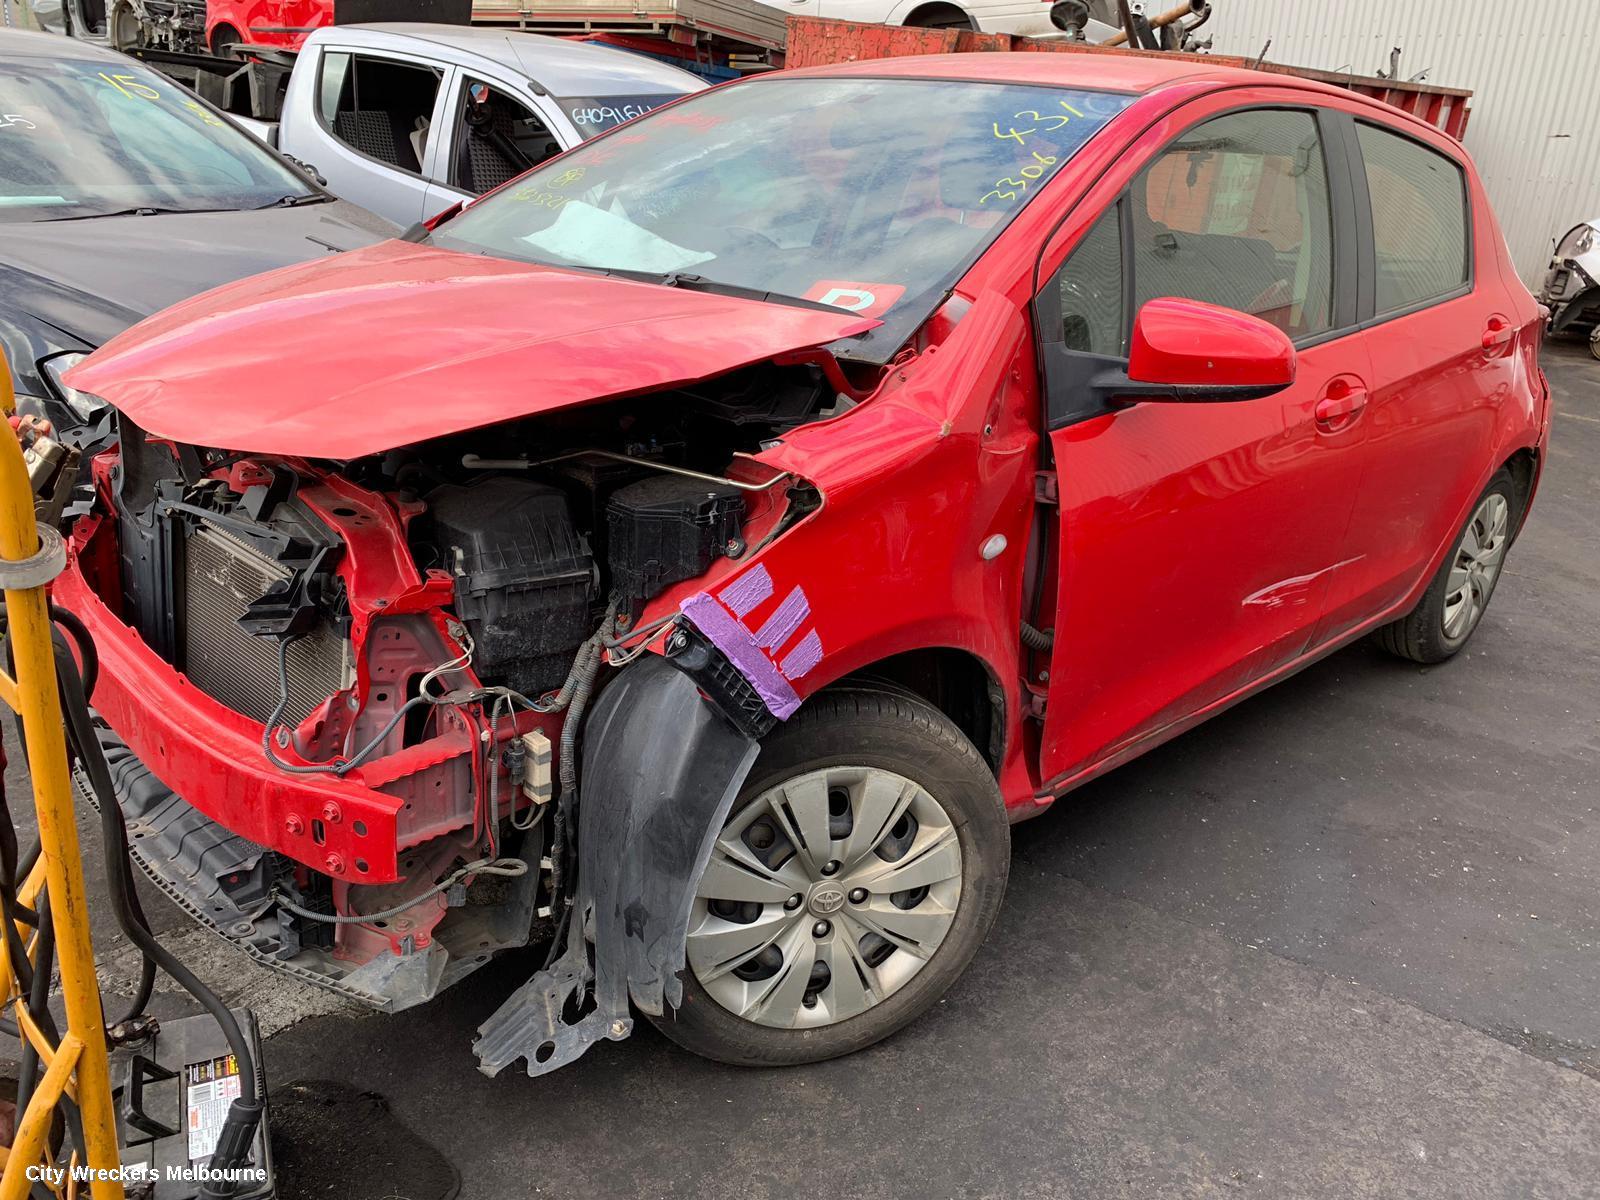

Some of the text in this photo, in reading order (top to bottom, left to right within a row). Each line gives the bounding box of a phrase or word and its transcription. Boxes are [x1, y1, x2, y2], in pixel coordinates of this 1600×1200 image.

[98, 72, 160, 100] 15
[993, 100, 1084, 145] 431
[979, 151, 1057, 204] 3306
